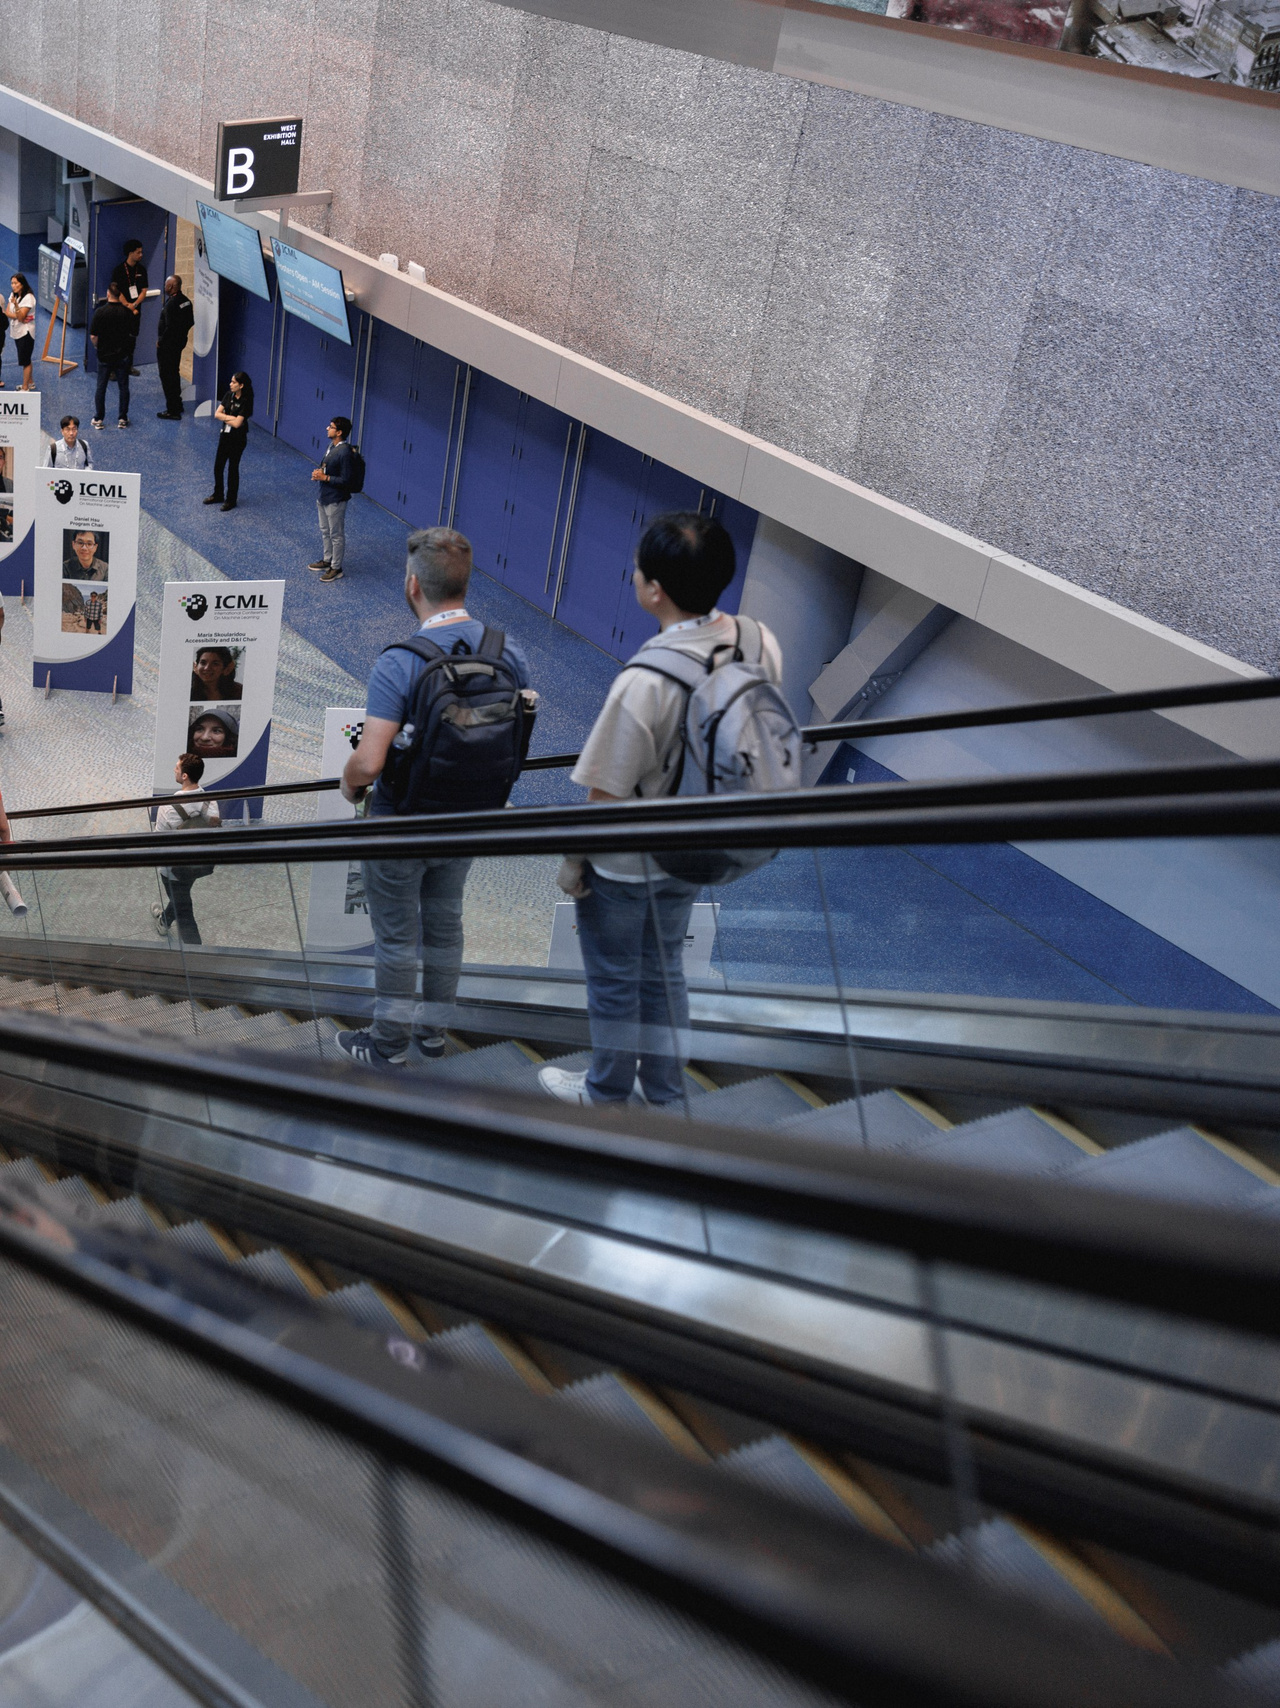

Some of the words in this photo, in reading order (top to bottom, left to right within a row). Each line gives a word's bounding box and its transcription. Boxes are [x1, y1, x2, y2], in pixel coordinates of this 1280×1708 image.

[263, 132, 296, 140] EXHIBITION
[227, 148, 255, 194] B
[206, 208, 220, 221] ICML
[281, 244, 297, 259] ICML
[80, 483, 127, 498] ICML
[215, 595, 268, 609] ICML
